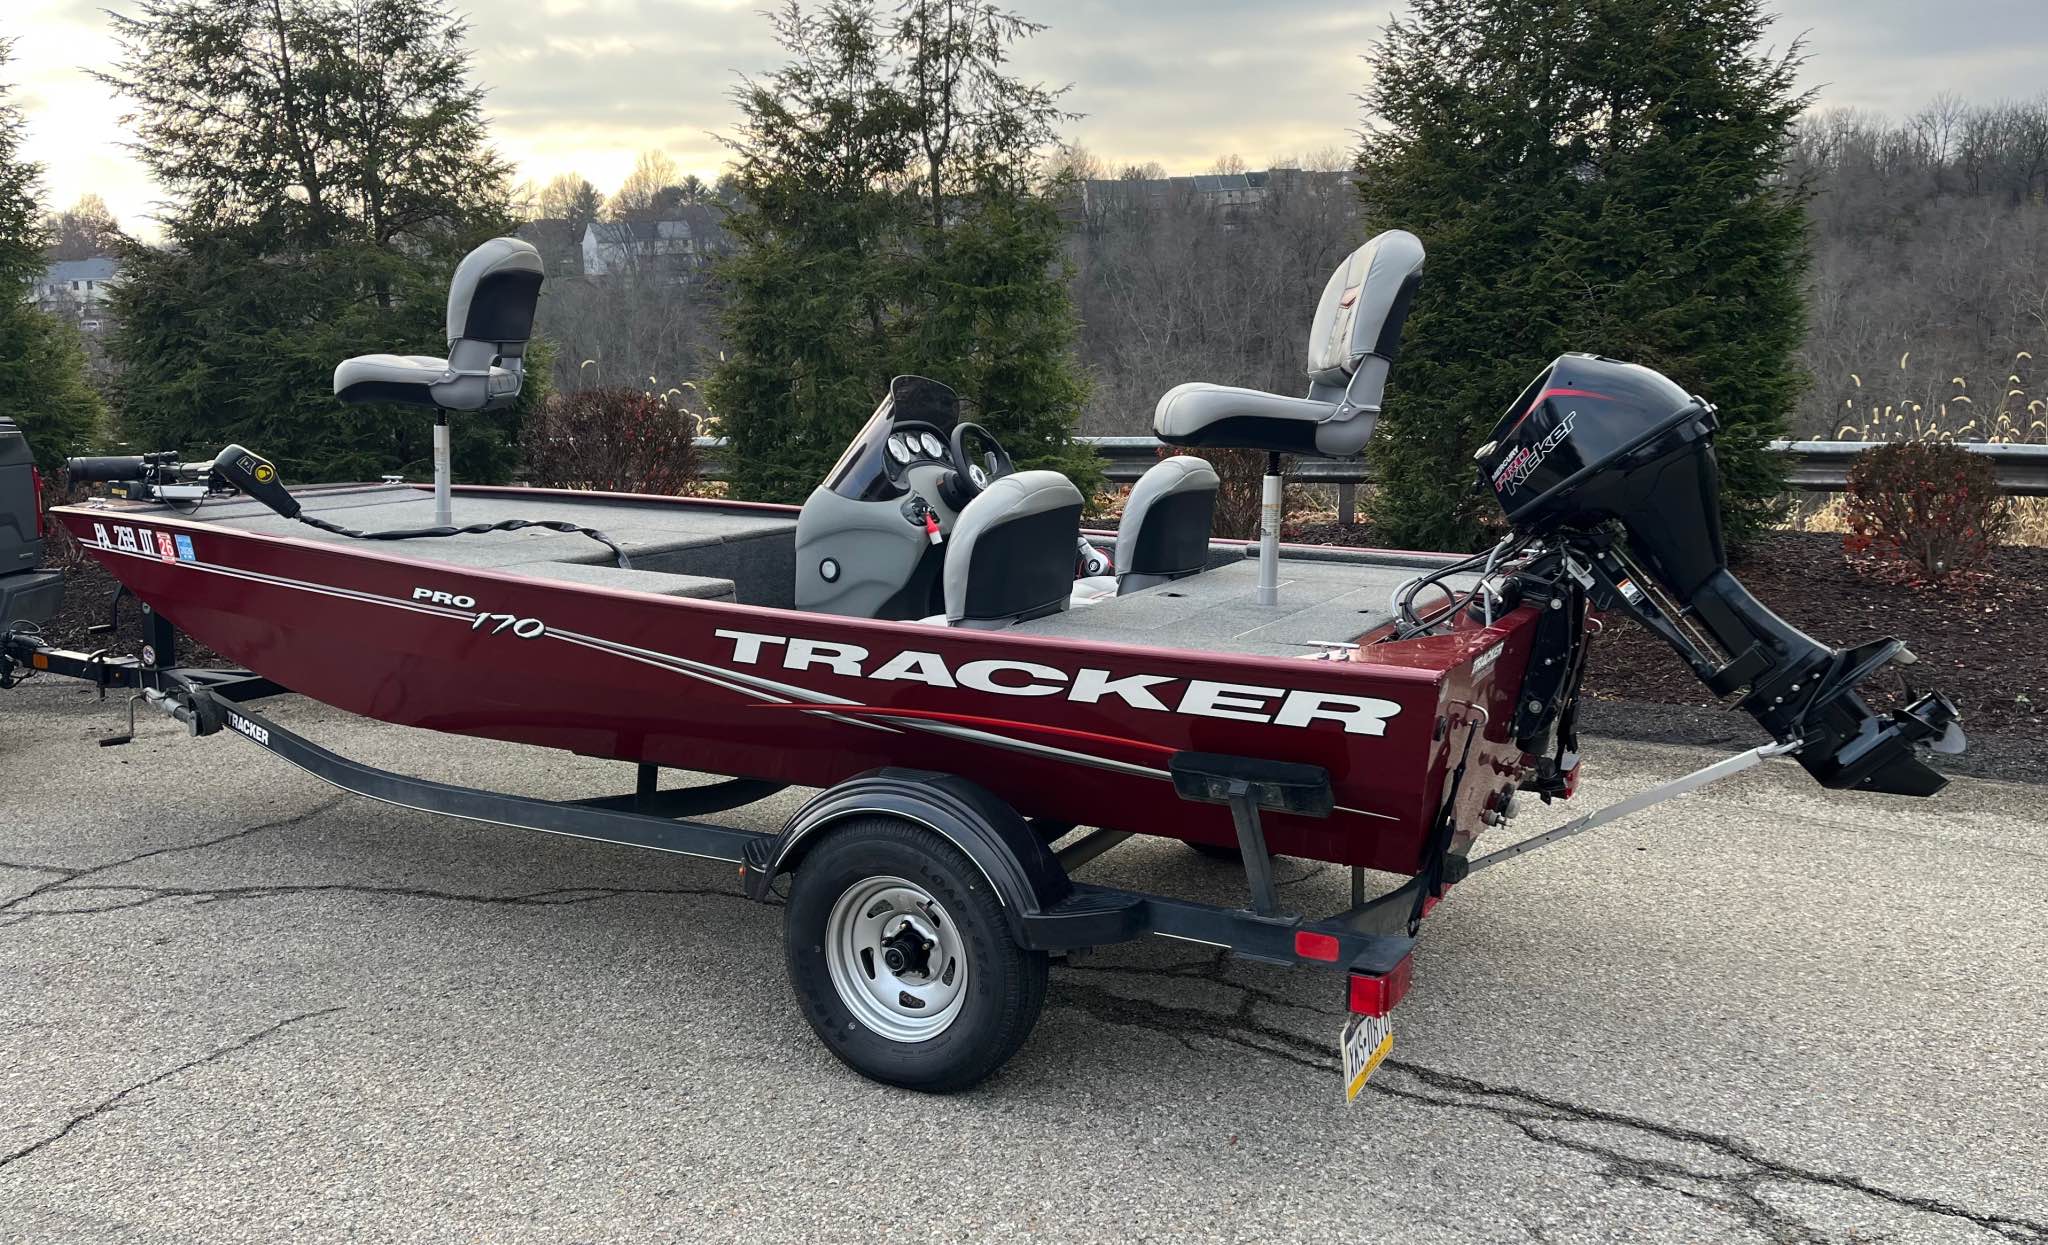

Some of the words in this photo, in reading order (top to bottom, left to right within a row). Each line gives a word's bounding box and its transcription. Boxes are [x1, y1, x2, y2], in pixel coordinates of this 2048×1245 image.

[1491, 444, 1519, 482] MERCURY
[1494, 447, 1530, 493] PRO
[93, 522, 112, 549] PA
[113, 525, 138, 553] 269
[158, 539, 174, 556] 26
[412, 587, 476, 608] PRO
[472, 612, 545, 638] 170
[713, 628, 1402, 736] TRACKER
[226, 710, 269, 746] TRACKER
